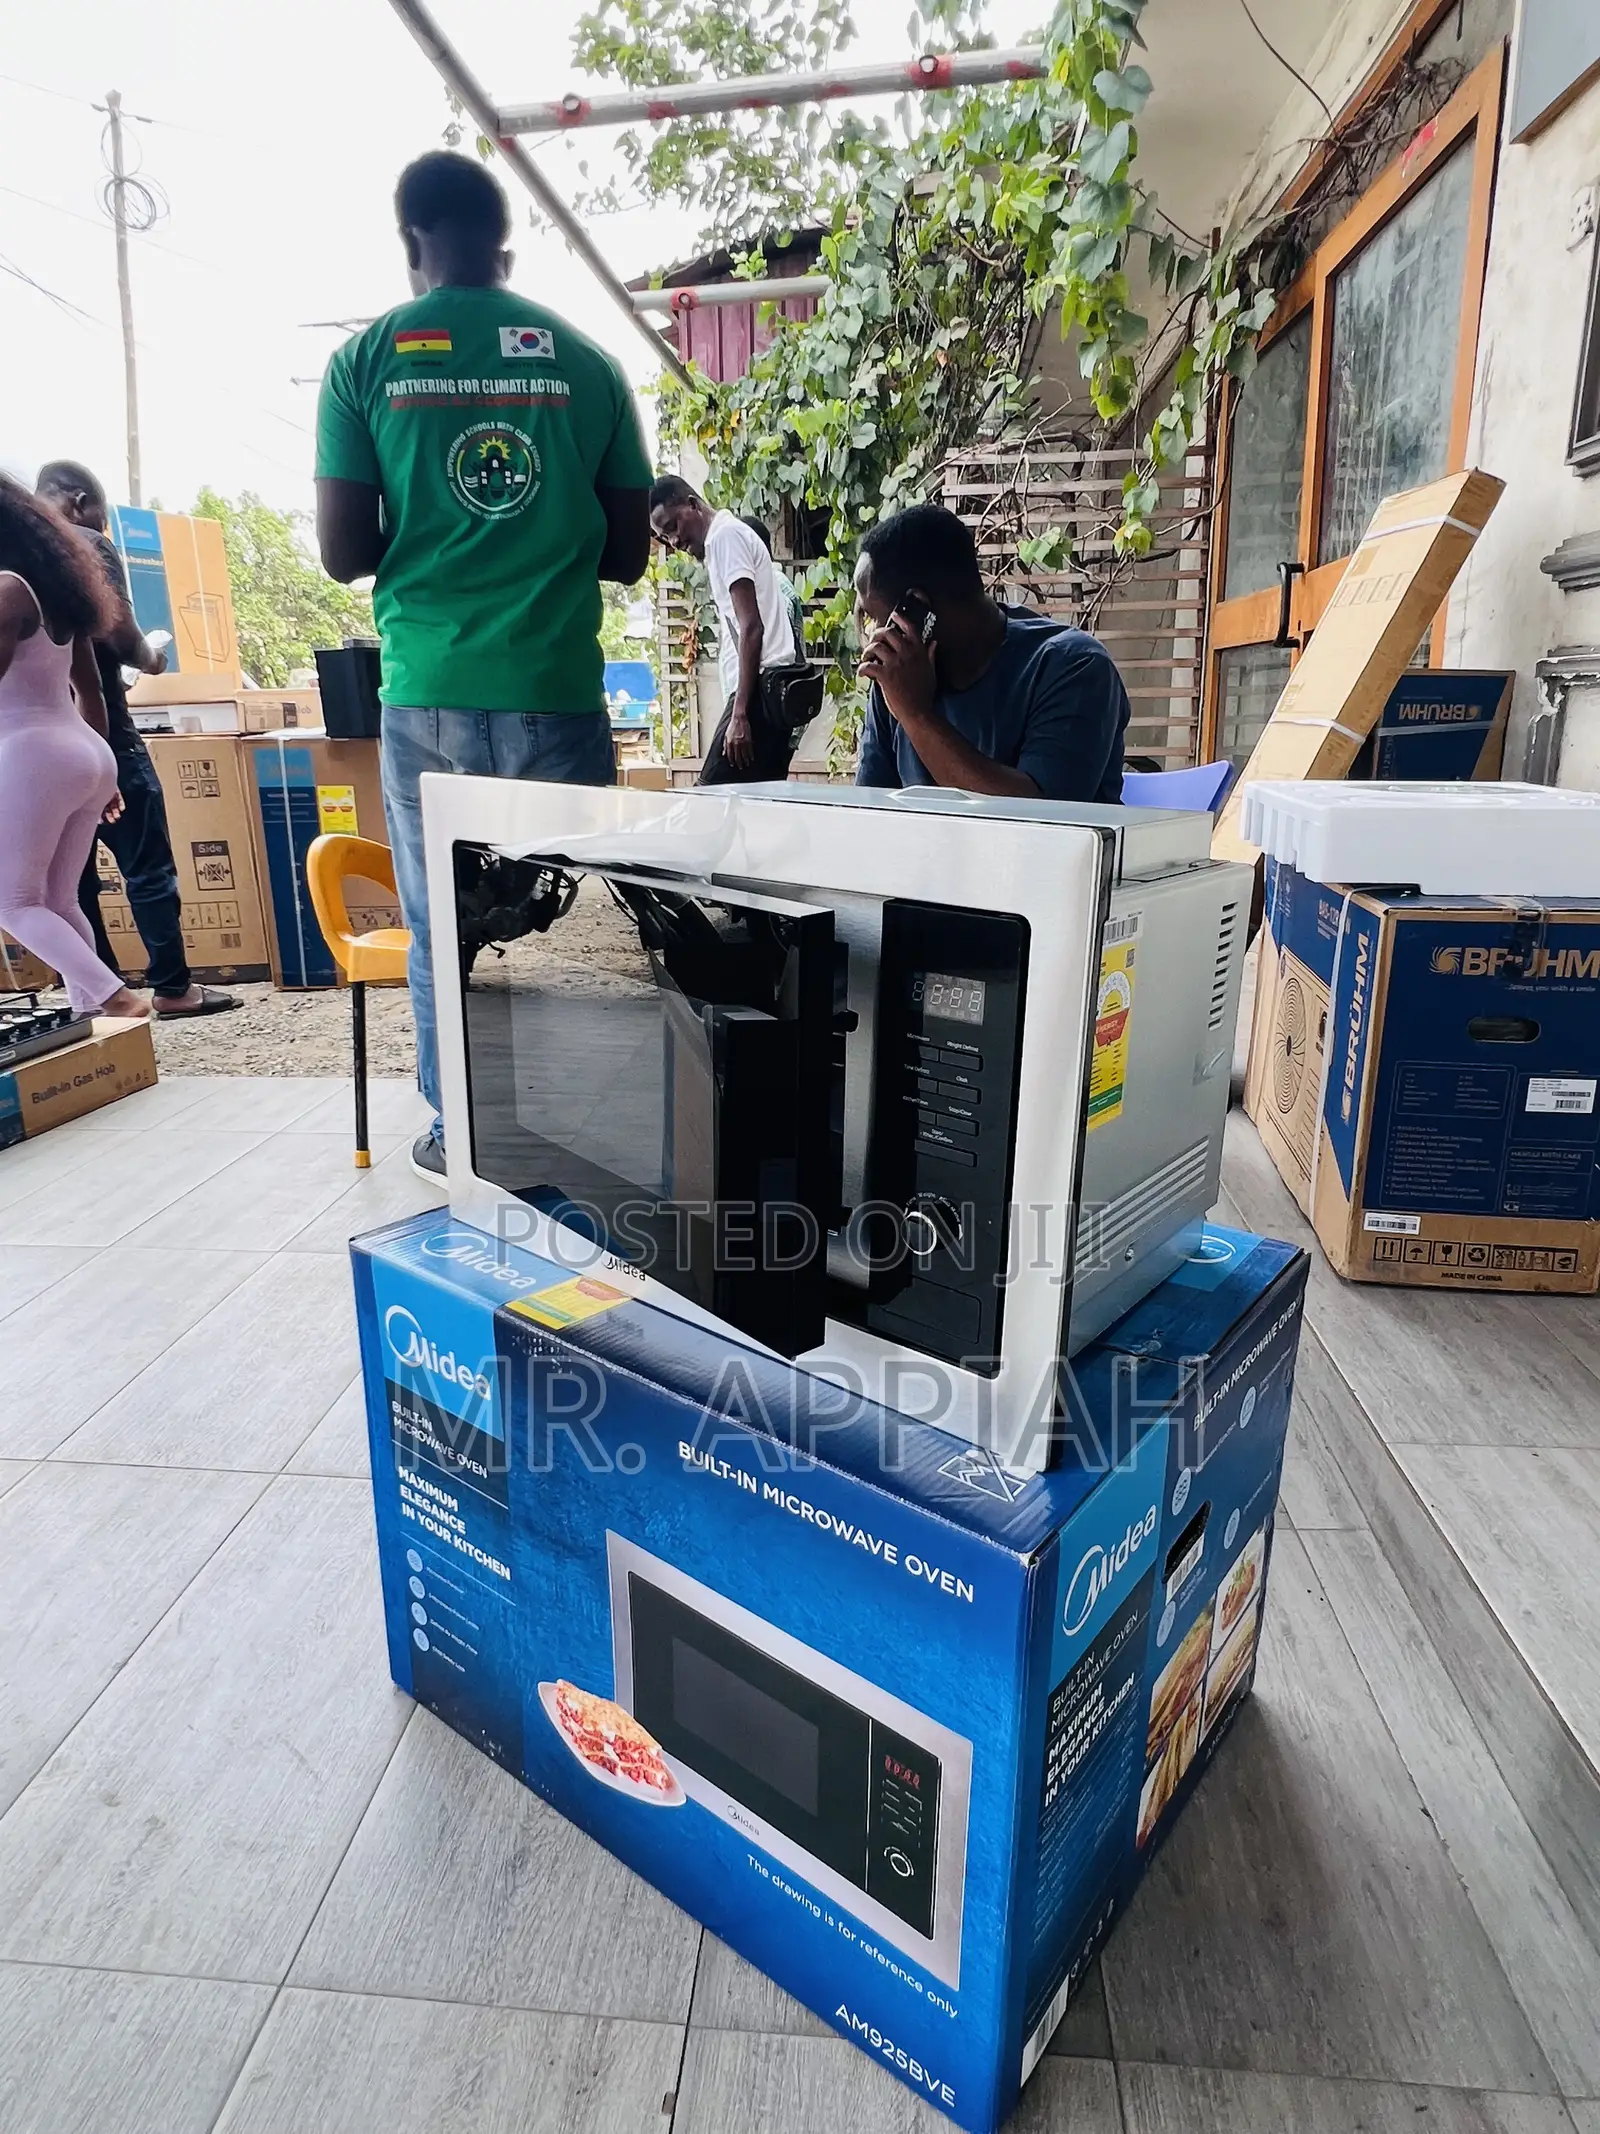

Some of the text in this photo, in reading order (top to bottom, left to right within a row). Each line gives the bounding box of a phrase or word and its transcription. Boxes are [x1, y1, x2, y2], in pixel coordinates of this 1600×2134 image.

[385, 378, 571, 398] PARTNERING FOR CLIMATE ACTION
[465, 421, 496, 437] SCHOOLS
[198, 843, 223, 854] Side
[73, 1071, 94, 1088] Gas
[95, 1062, 116, 1079] Hob
[420, 1232, 537, 1291] Midea
[603, 1255, 646, 1282] Midea
[1440, 1271, 1503, 1282] MADE IN CHINA
[385, 1304, 492, 1401] Midea
[391, 1400, 433, 1433] BUILT-IN
[393, 1415, 489, 1480] MICROWAVE OVEN
[398, 1465, 460, 1513] MAXIMUM
[400, 1483, 467, 1536] ELEGANCE
[401, 1501, 416, 1522] IN
[417, 1511, 452, 1545] YOUR
[453, 1533, 512, 1582] KITCHEN
[678, 1440, 975, 1604] BUILT-IN MICROWAVE OVEN
[1062, 1503, 1157, 1637] Midea
[1050, 1644, 1112, 1734] MICROWAVE
[1113, 1609, 1140, 1650] OVEN
[1052, 1650, 1096, 1714] BUILT-IN
[1044, 1781, 1058, 1808] IN
[1060, 1740, 1090, 1784] YOUR
[1091, 1671, 1135, 1741] KITCHEN
[1046, 1696, 1106, 1787] ELEGANCE
[1048, 1681, 1103, 1765] MAXIMUM
[726, 1804, 761, 1837] Midea
[746, 1853, 959, 2019] The drawing is for reference only
[834, 2002, 956, 2109] AM925BVE
